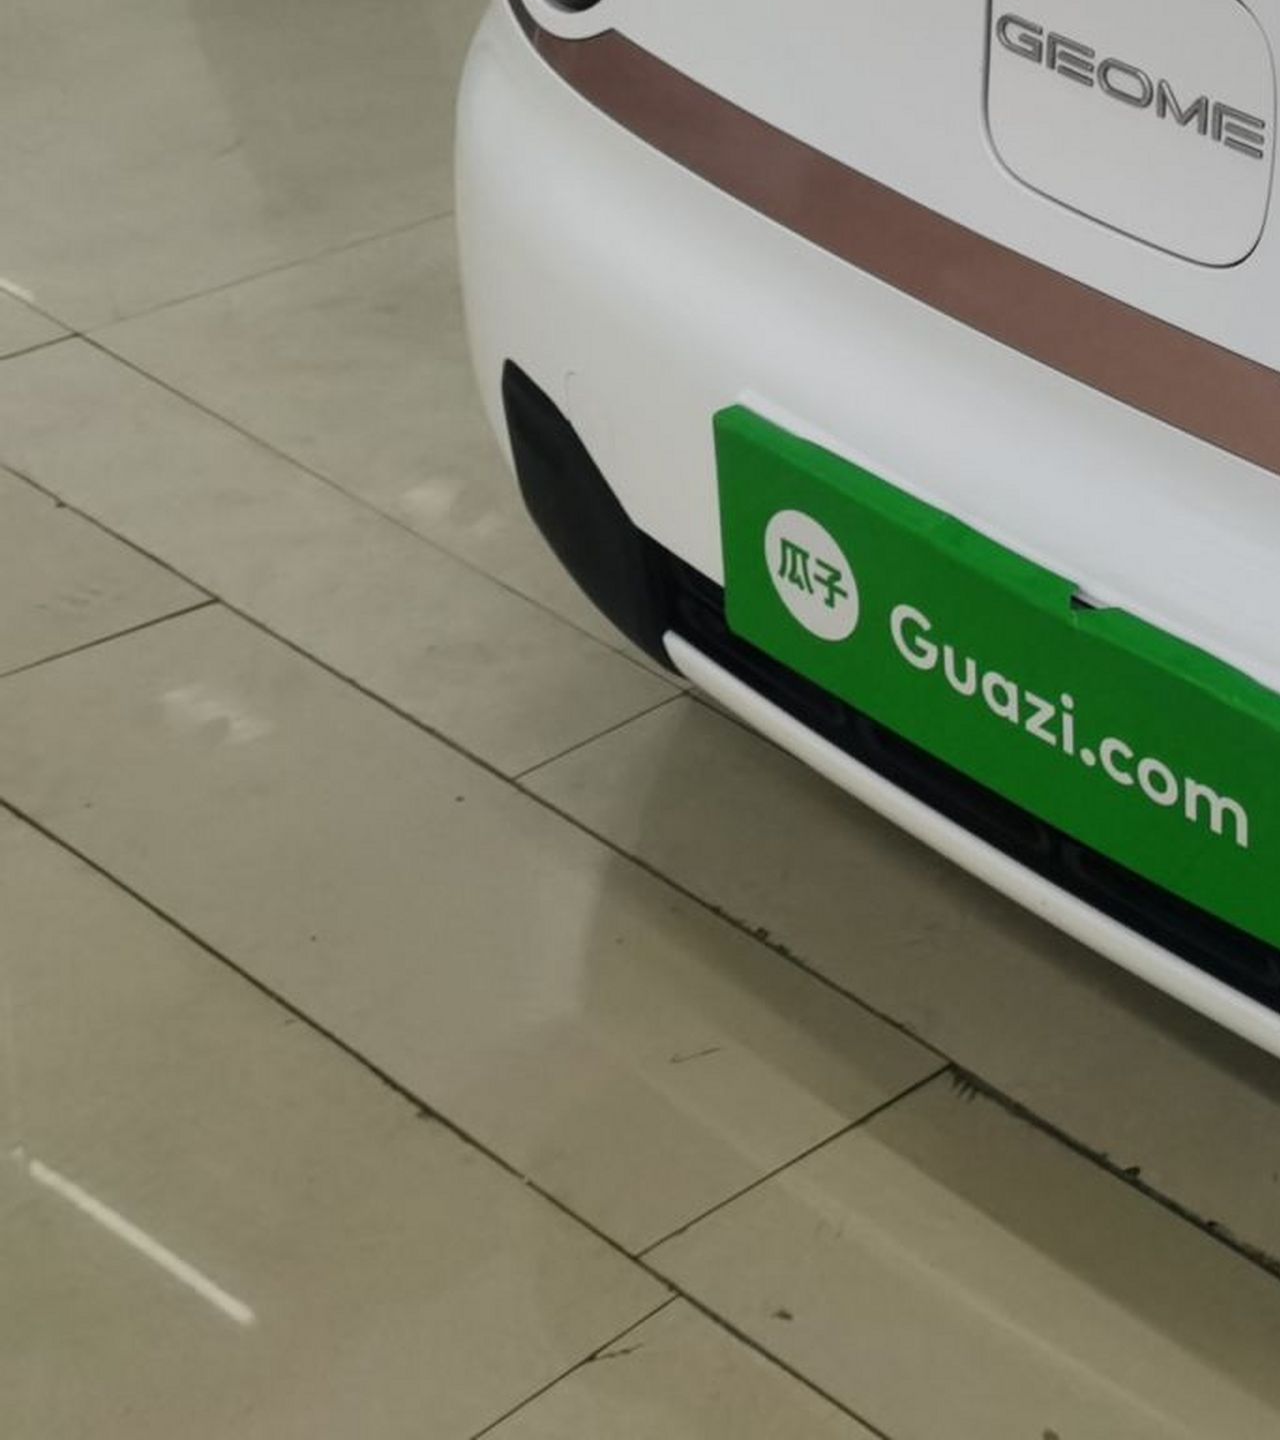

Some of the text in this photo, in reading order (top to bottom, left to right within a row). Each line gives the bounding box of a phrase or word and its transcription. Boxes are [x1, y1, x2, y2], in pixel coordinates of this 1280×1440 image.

[996, 13, 1265, 160] GEOME
[777, 537, 848, 610] 瓜子
[889, 604, 1249, 848] Guazi.com
